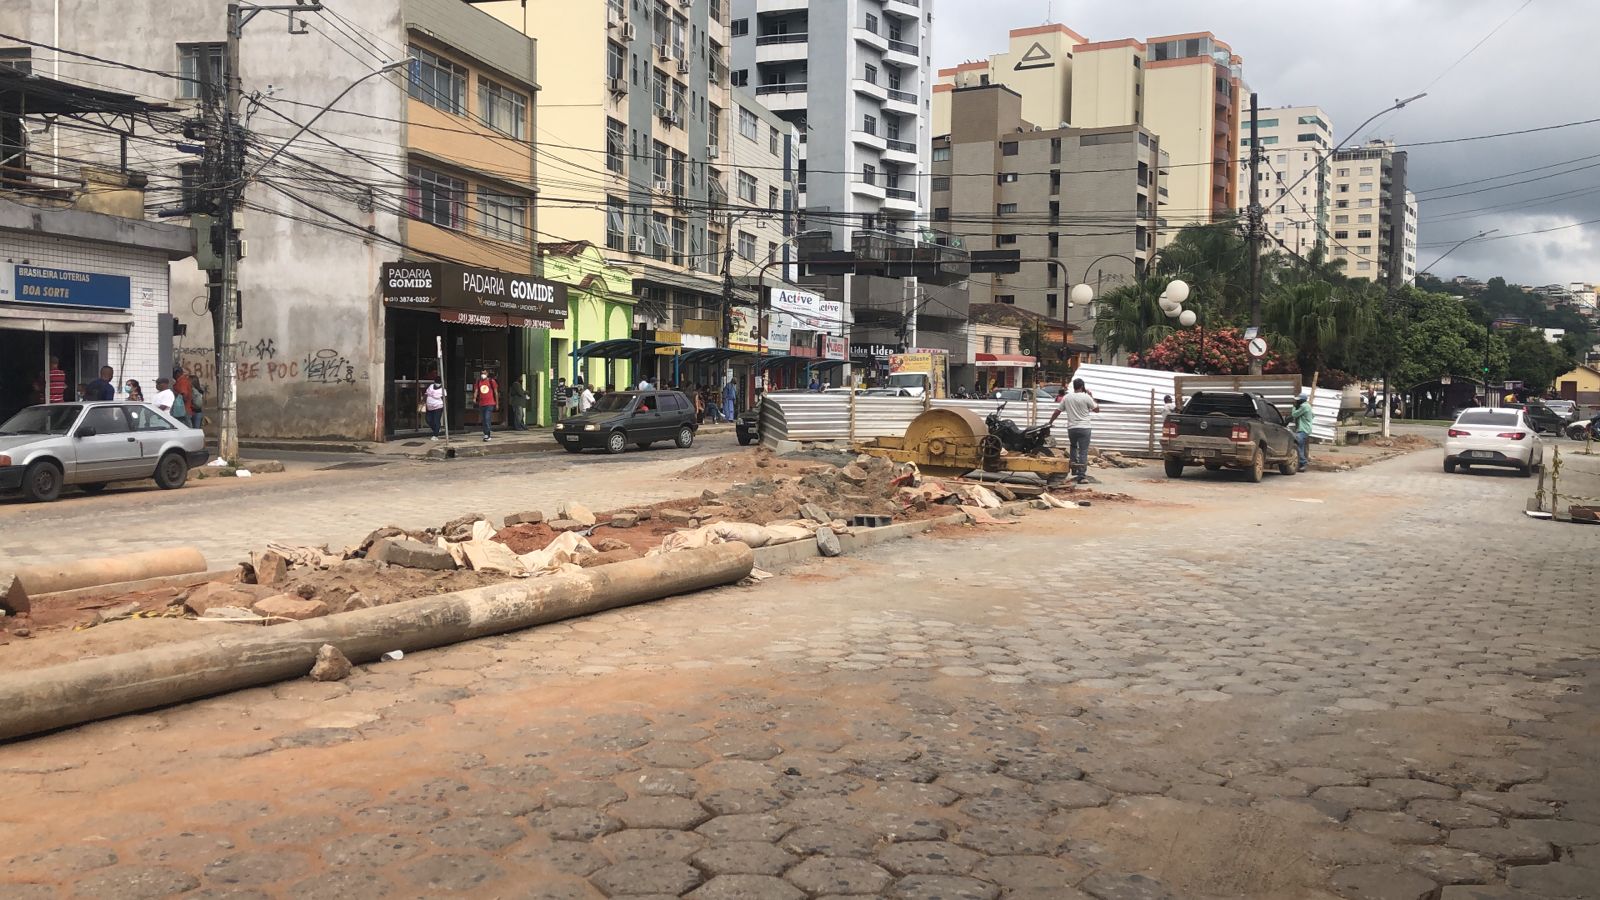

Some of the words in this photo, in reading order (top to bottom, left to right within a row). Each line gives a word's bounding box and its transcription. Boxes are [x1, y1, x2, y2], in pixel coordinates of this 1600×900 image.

[18, 267, 58, 280] BRASILEIRA
[60, 271, 90, 283] LOTERIAS
[389, 268, 432, 279] PADARIA
[389, 279, 432, 288] GOMIDE
[463, 272, 505, 296] PADARIA
[510, 280, 554, 303] GOMIDE
[22, 284, 41, 297] BOA
[42, 286, 70, 299] SORTE
[779, 290, 813, 305] Active
[267, 361, 298, 381] POC
